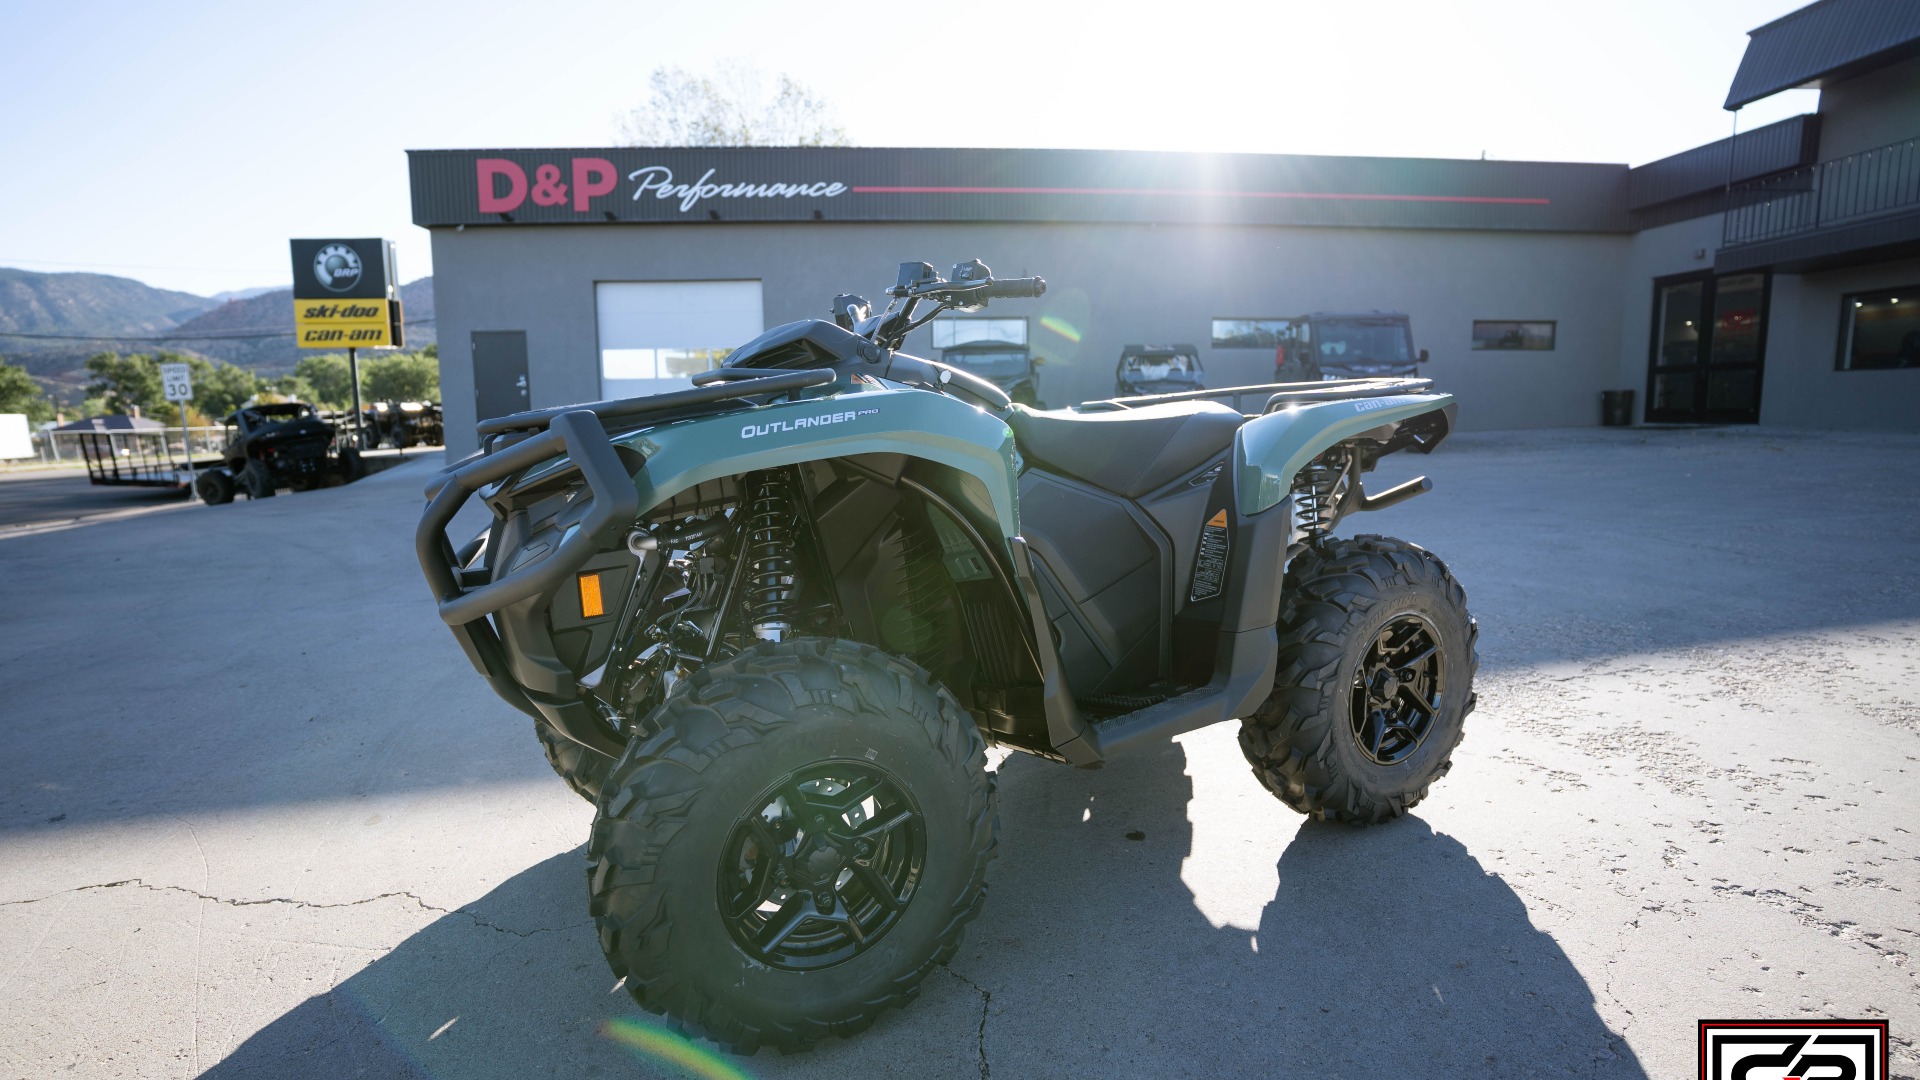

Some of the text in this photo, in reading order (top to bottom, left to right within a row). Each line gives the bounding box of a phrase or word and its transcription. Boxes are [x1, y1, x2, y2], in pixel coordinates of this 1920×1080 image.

[476, 157, 848, 213] D&P Performance
[333, 268, 360, 278] BRP
[303, 304, 379, 318] ski-doo
[304, 329, 383, 342] can-am
[168, 384, 187, 396] 30
[741, 408, 879, 439] OUTLANDER PRO
